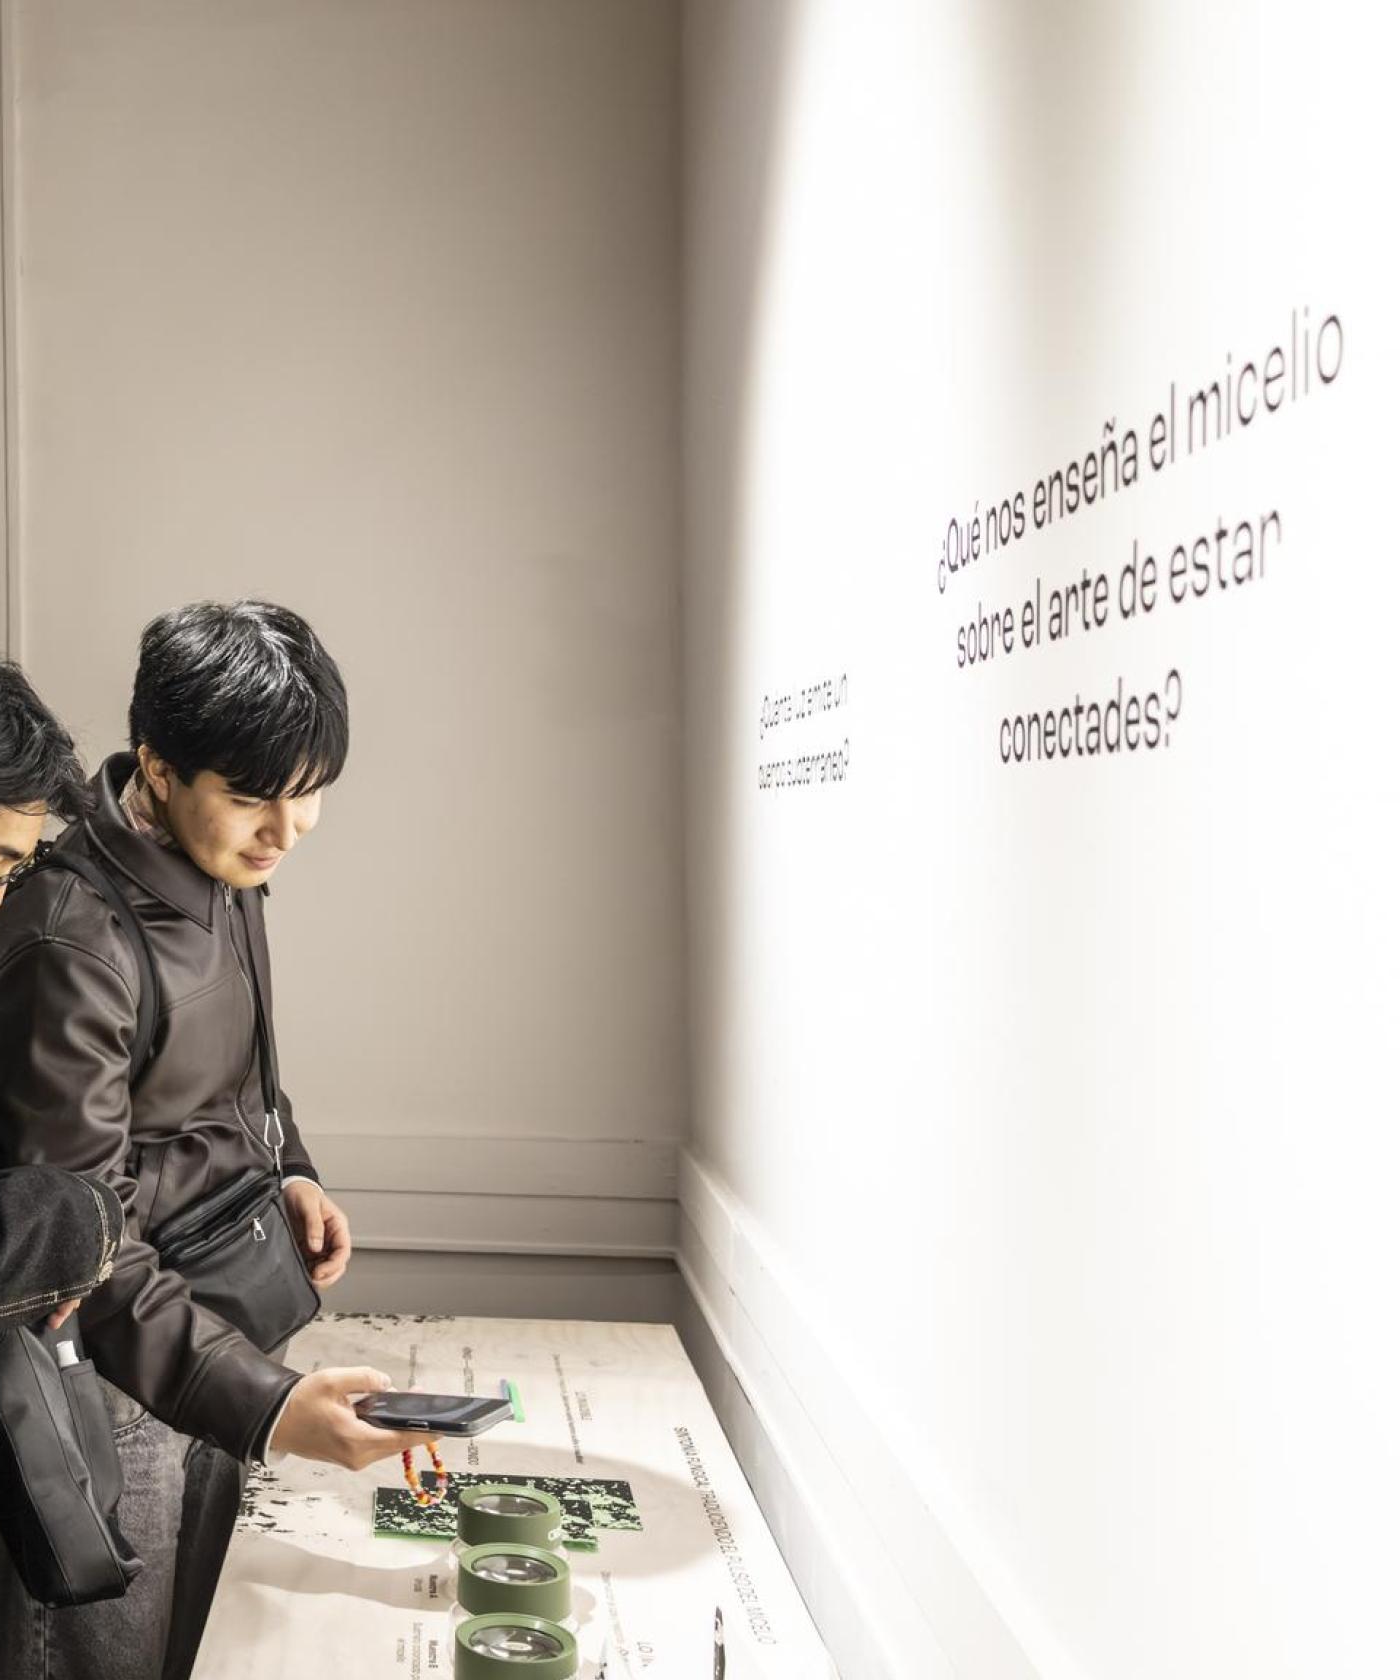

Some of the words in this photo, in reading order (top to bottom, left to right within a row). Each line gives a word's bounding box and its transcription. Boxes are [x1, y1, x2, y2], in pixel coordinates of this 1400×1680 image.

[938, 500, 981, 596] ¿Qué
[986, 490, 1027, 556] nos
[1032, 416, 1140, 531] enseña
[1149, 381, 1176, 473] el
[1188, 305, 1344, 456] micelio
[957, 600, 1016, 670] sobre
[1021, 577, 1041, 650] el
[1048, 567, 1111, 642] arte
[1118, 538, 1159, 622] de
[1168, 508, 1282, 606] estar
[999, 666, 1183, 766] conectades?
